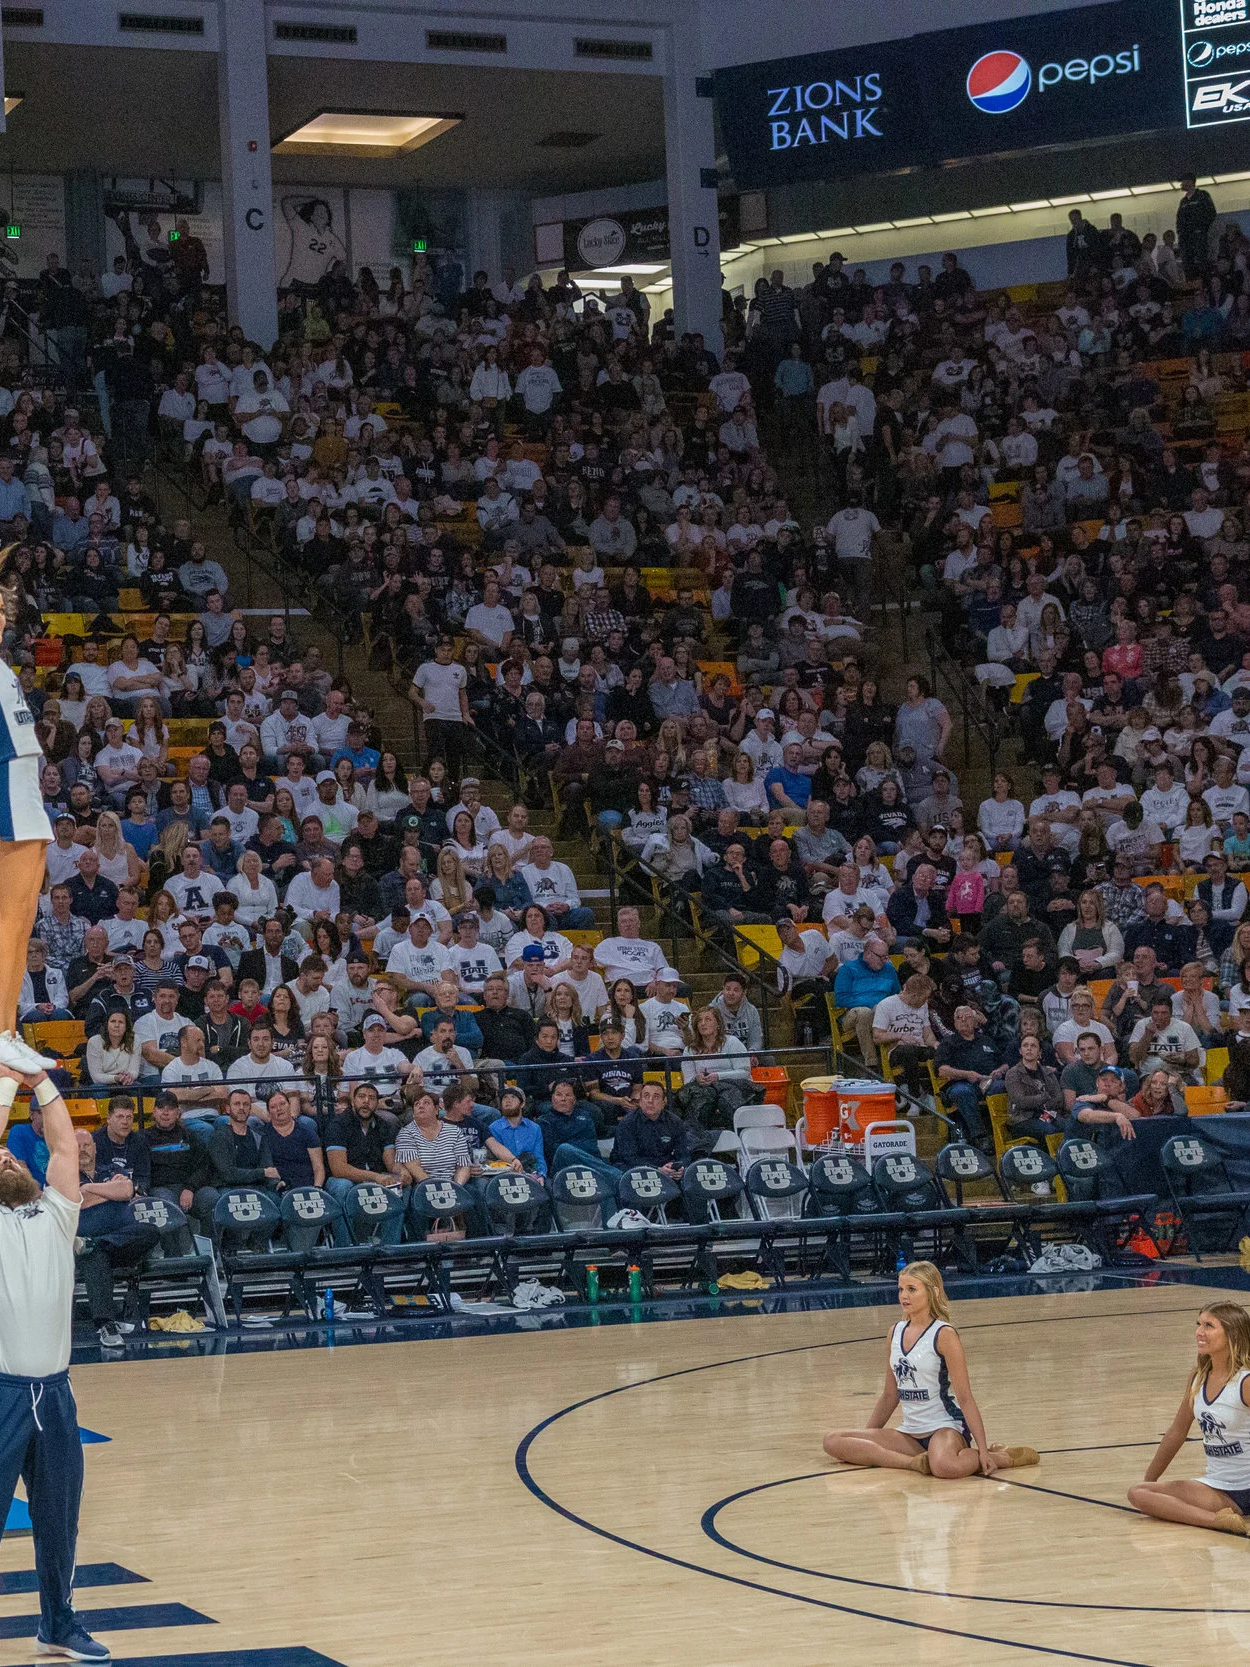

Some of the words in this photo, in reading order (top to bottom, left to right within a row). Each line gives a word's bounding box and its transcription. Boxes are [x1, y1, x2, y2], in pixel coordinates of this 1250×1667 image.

[1193, 0, 1247, 15] Honda
[1195, 10, 1247, 27] dealers
[1038, 43, 1140, 92] pepsi
[767, 73, 883, 117] ZIONS
[769, 107, 884, 150] BANK
[245, 208, 264, 231] C
[693, 226, 710, 247] D
[635, 818, 666, 830] Aggies
[183, 886, 209, 910] A
[1150, 1044, 1183, 1053] TATE
[872, 1140, 908, 1149] GATORADE
